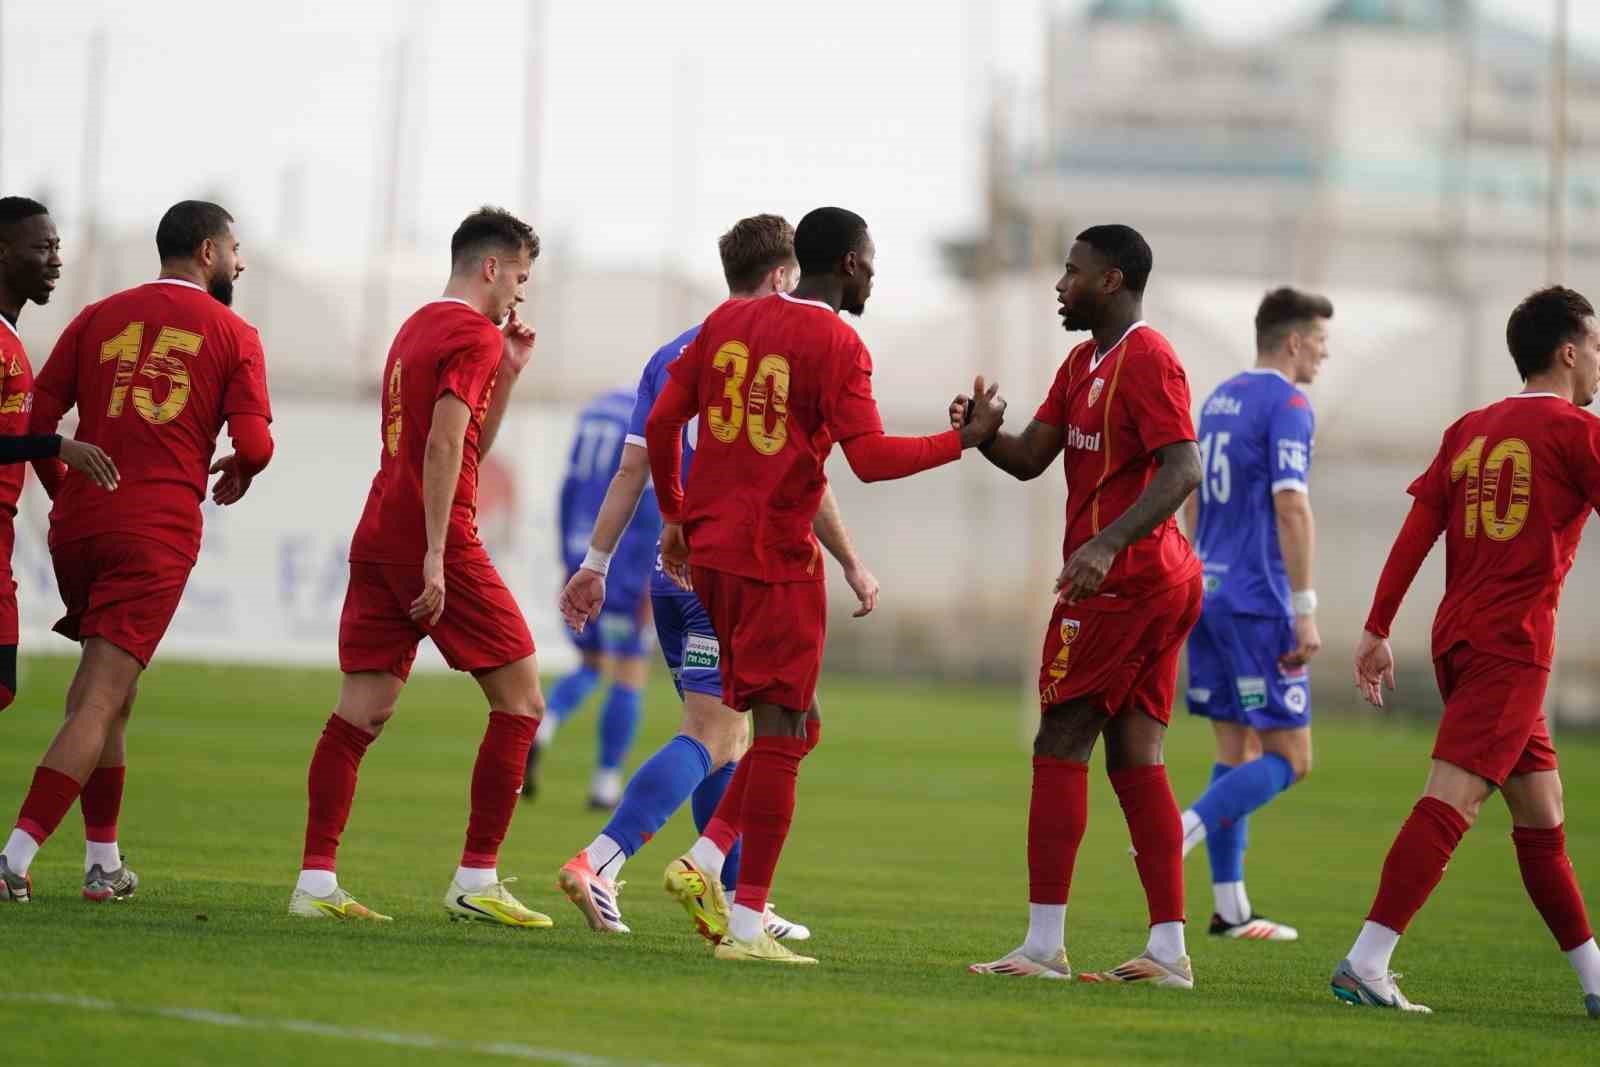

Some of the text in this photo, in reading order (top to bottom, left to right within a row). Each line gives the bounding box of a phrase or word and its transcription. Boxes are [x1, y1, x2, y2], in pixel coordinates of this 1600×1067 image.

[100, 321, 204, 424] 15
[708, 339, 790, 455] 30
[1199, 431, 1231, 504] 15
[1450, 435, 1532, 541] 10
